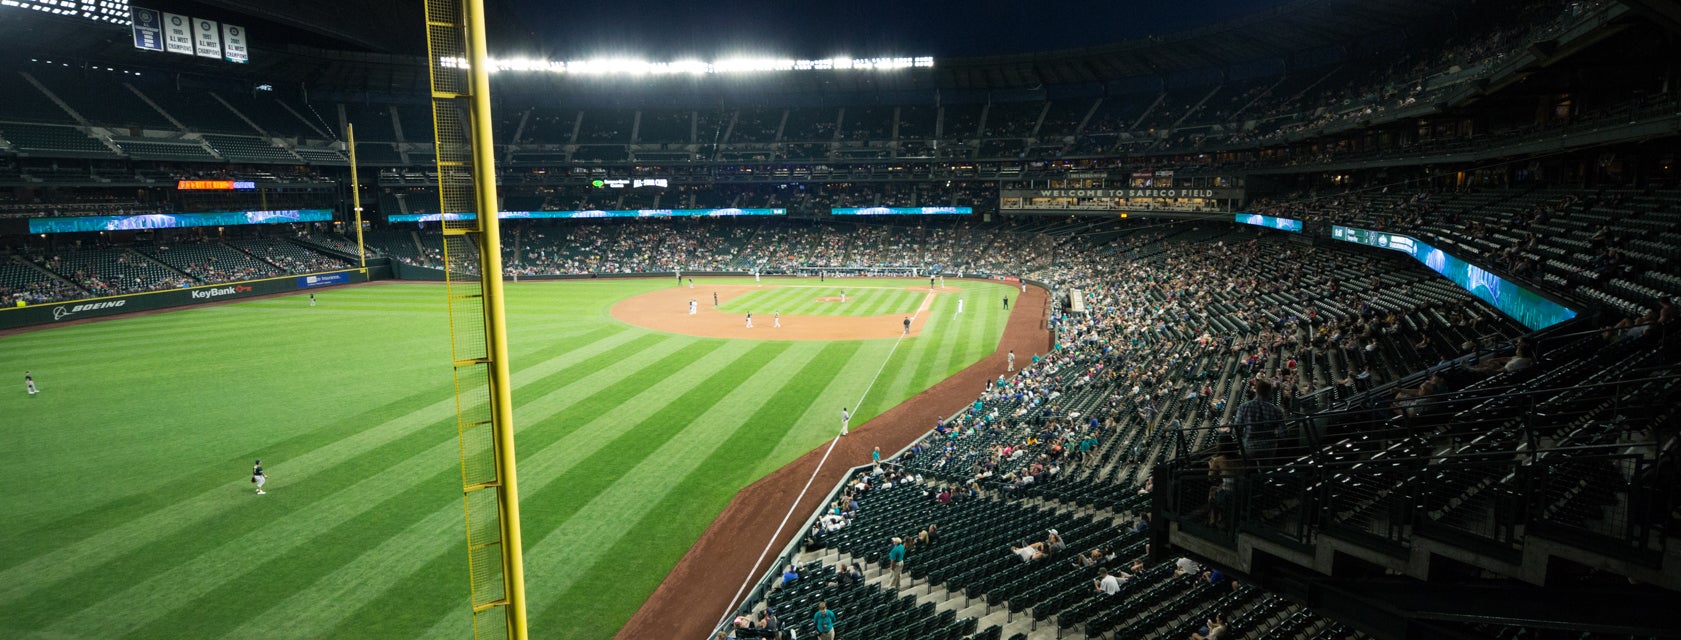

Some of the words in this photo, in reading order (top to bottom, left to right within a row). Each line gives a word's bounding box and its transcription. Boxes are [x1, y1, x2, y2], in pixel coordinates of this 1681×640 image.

[168, 43, 192, 52] CHAMPIONS
[198, 48, 220, 56] CHAMPIONS
[1041, 189, 1103, 197] WELCOME
[1109, 189, 1124, 197] TO
[1129, 189, 1176, 197] SAFECO
[1181, 189, 1213, 197] FIELD
[192, 286, 236, 299] KeyBank
[72, 300, 126, 312] BOEING
